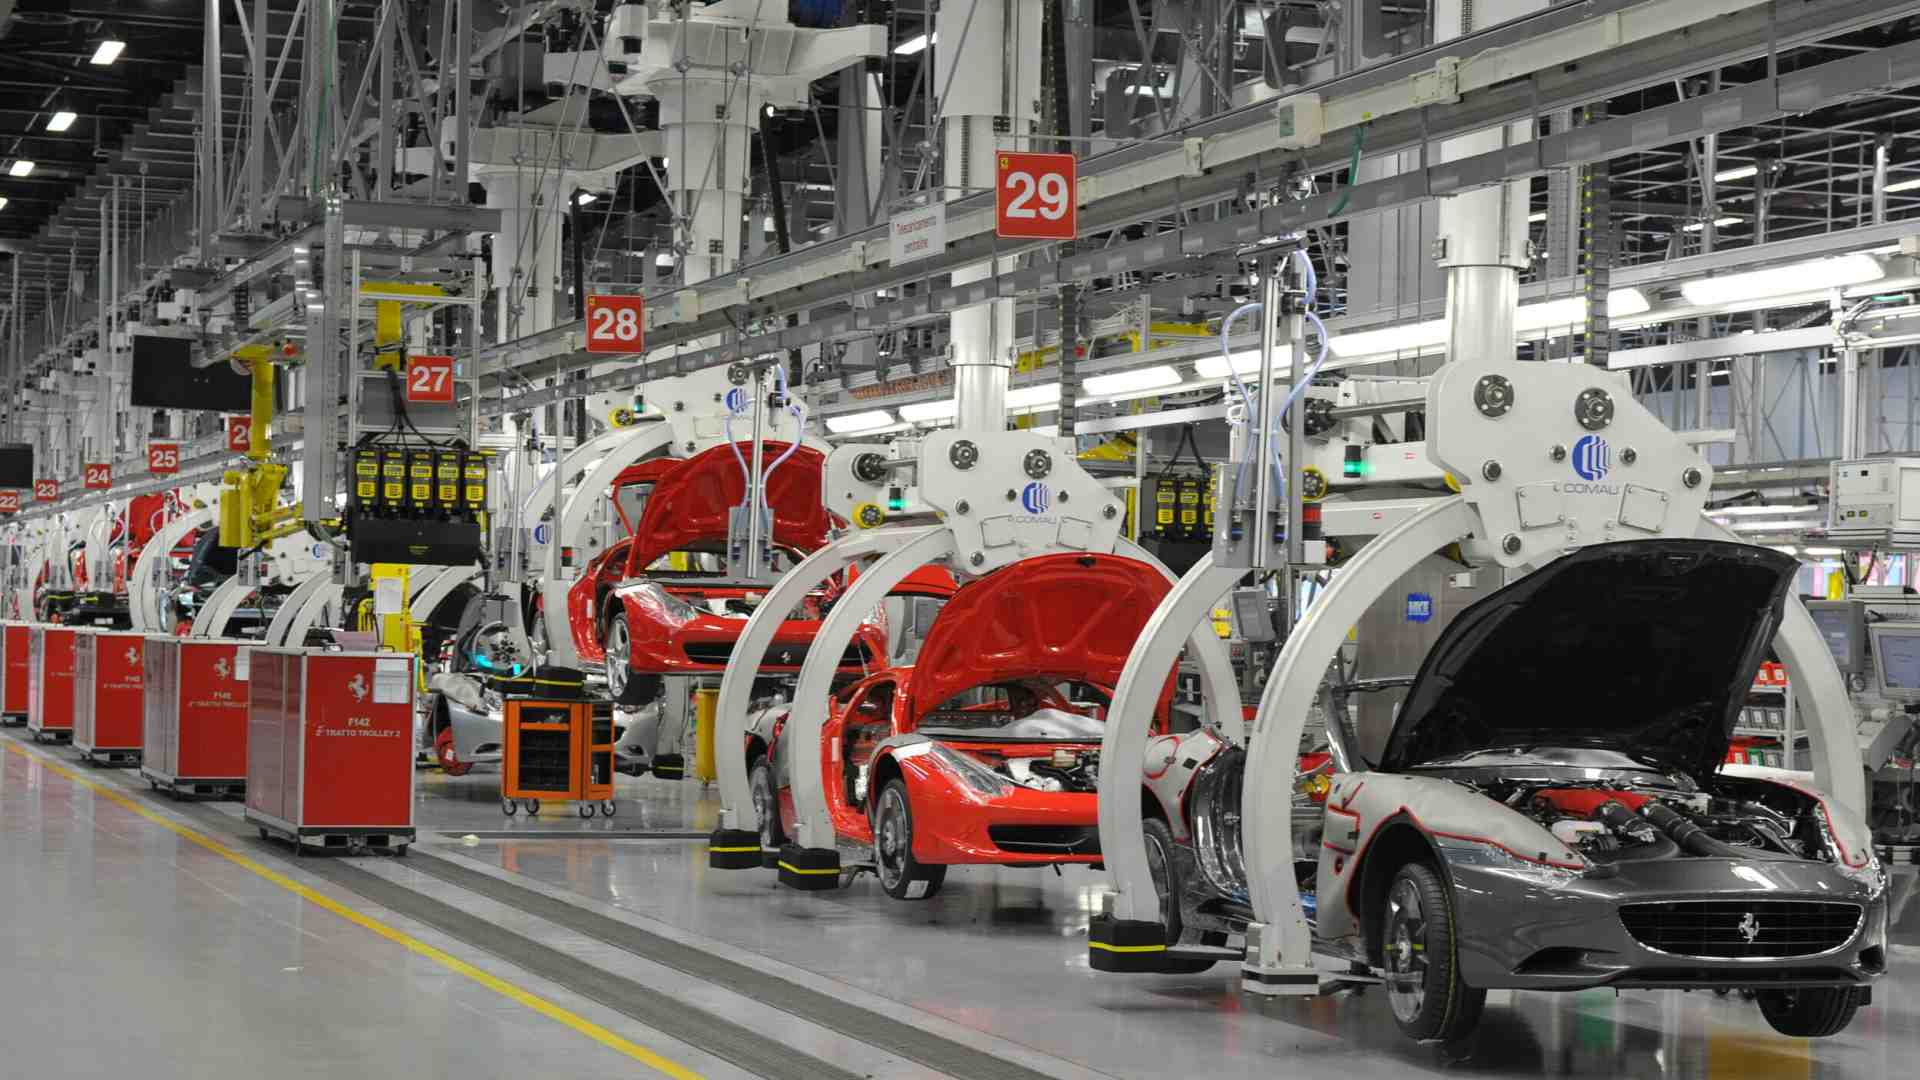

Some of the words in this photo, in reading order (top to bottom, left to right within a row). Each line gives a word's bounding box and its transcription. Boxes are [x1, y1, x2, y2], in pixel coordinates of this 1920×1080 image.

[1006, 171, 1069, 220] 29
[592, 307, 638, 341] 28
[412, 366, 449, 392] 27
[151, 450, 177, 468] 25
[87, 469, 108, 484] 24
[38, 484, 56, 497] 23
[1563, 483, 1619, 496] COMAU
[348, 718, 370, 727] F142
[326, 729, 357, 737] TRATTO
[359, 729, 393, 737] TROLLEY
[393, 730, 401, 738] 2
